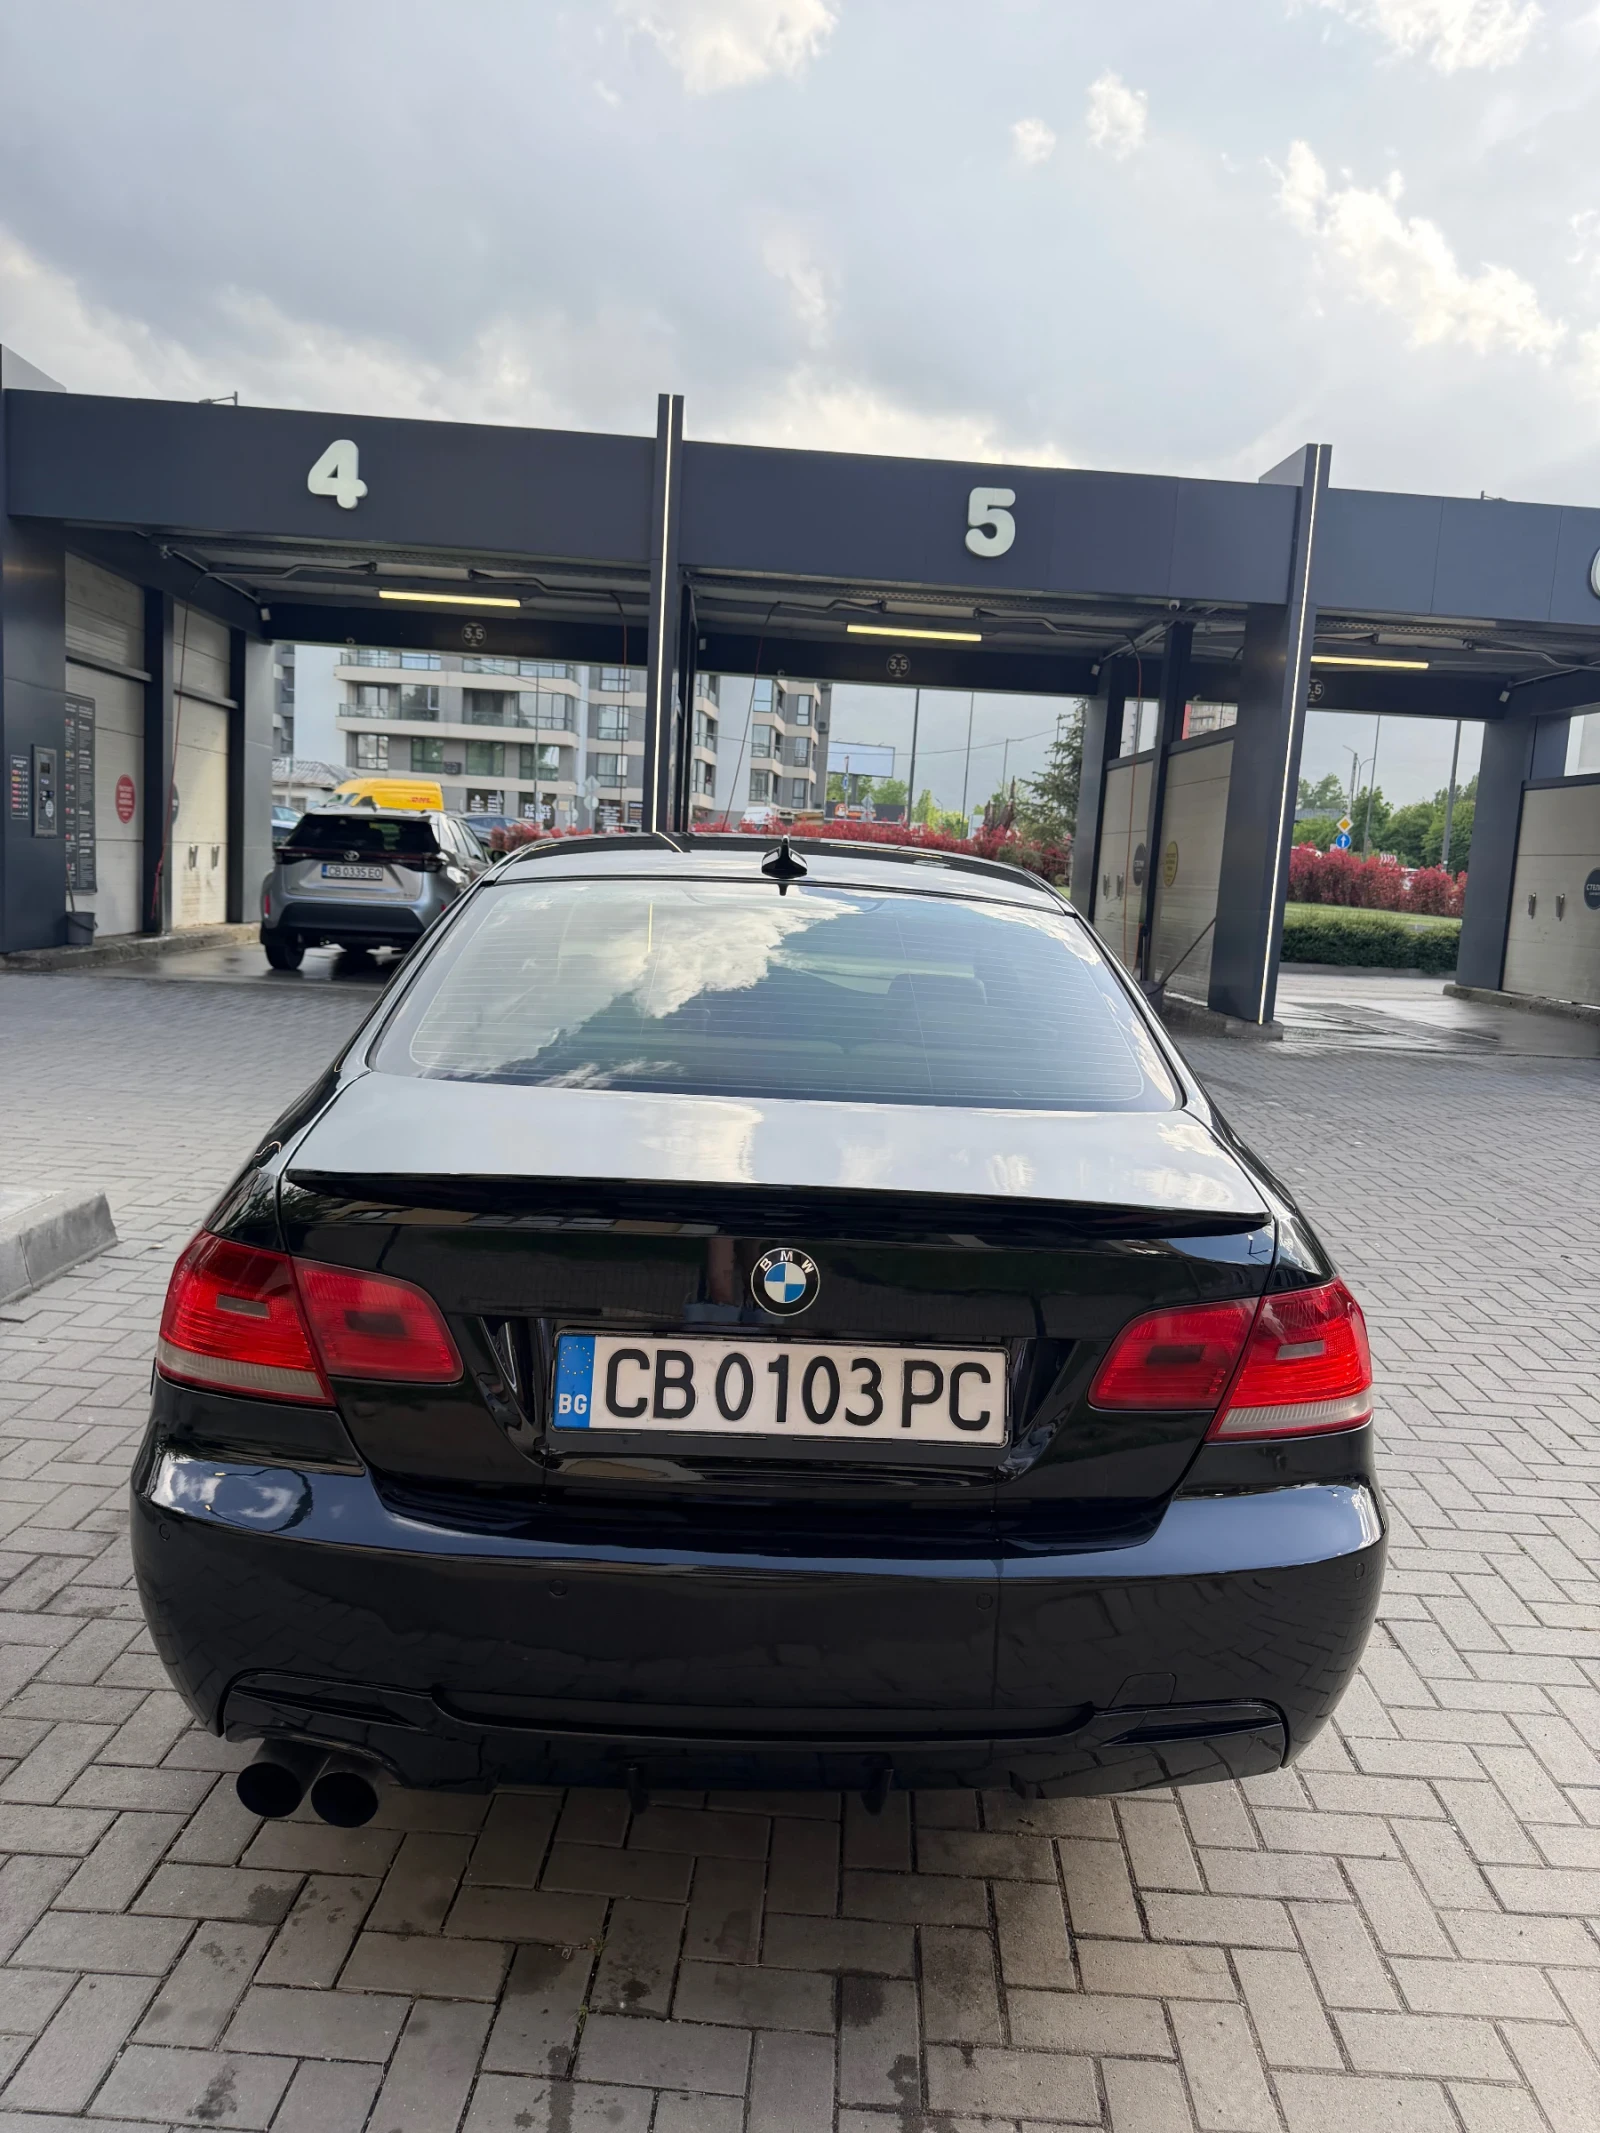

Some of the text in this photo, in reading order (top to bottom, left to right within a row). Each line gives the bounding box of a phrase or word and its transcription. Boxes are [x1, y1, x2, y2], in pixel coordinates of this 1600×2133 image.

[307, 439, 368, 510] 4
[965, 487, 1016, 557] 5
[328, 866, 342, 877] CB
[343, 867, 367, 878] 0335
[760, 1250, 815, 1274] BMW
[558, 1393, 587, 1416] BG
[605, 1348, 992, 1432] CB 0103 PC
